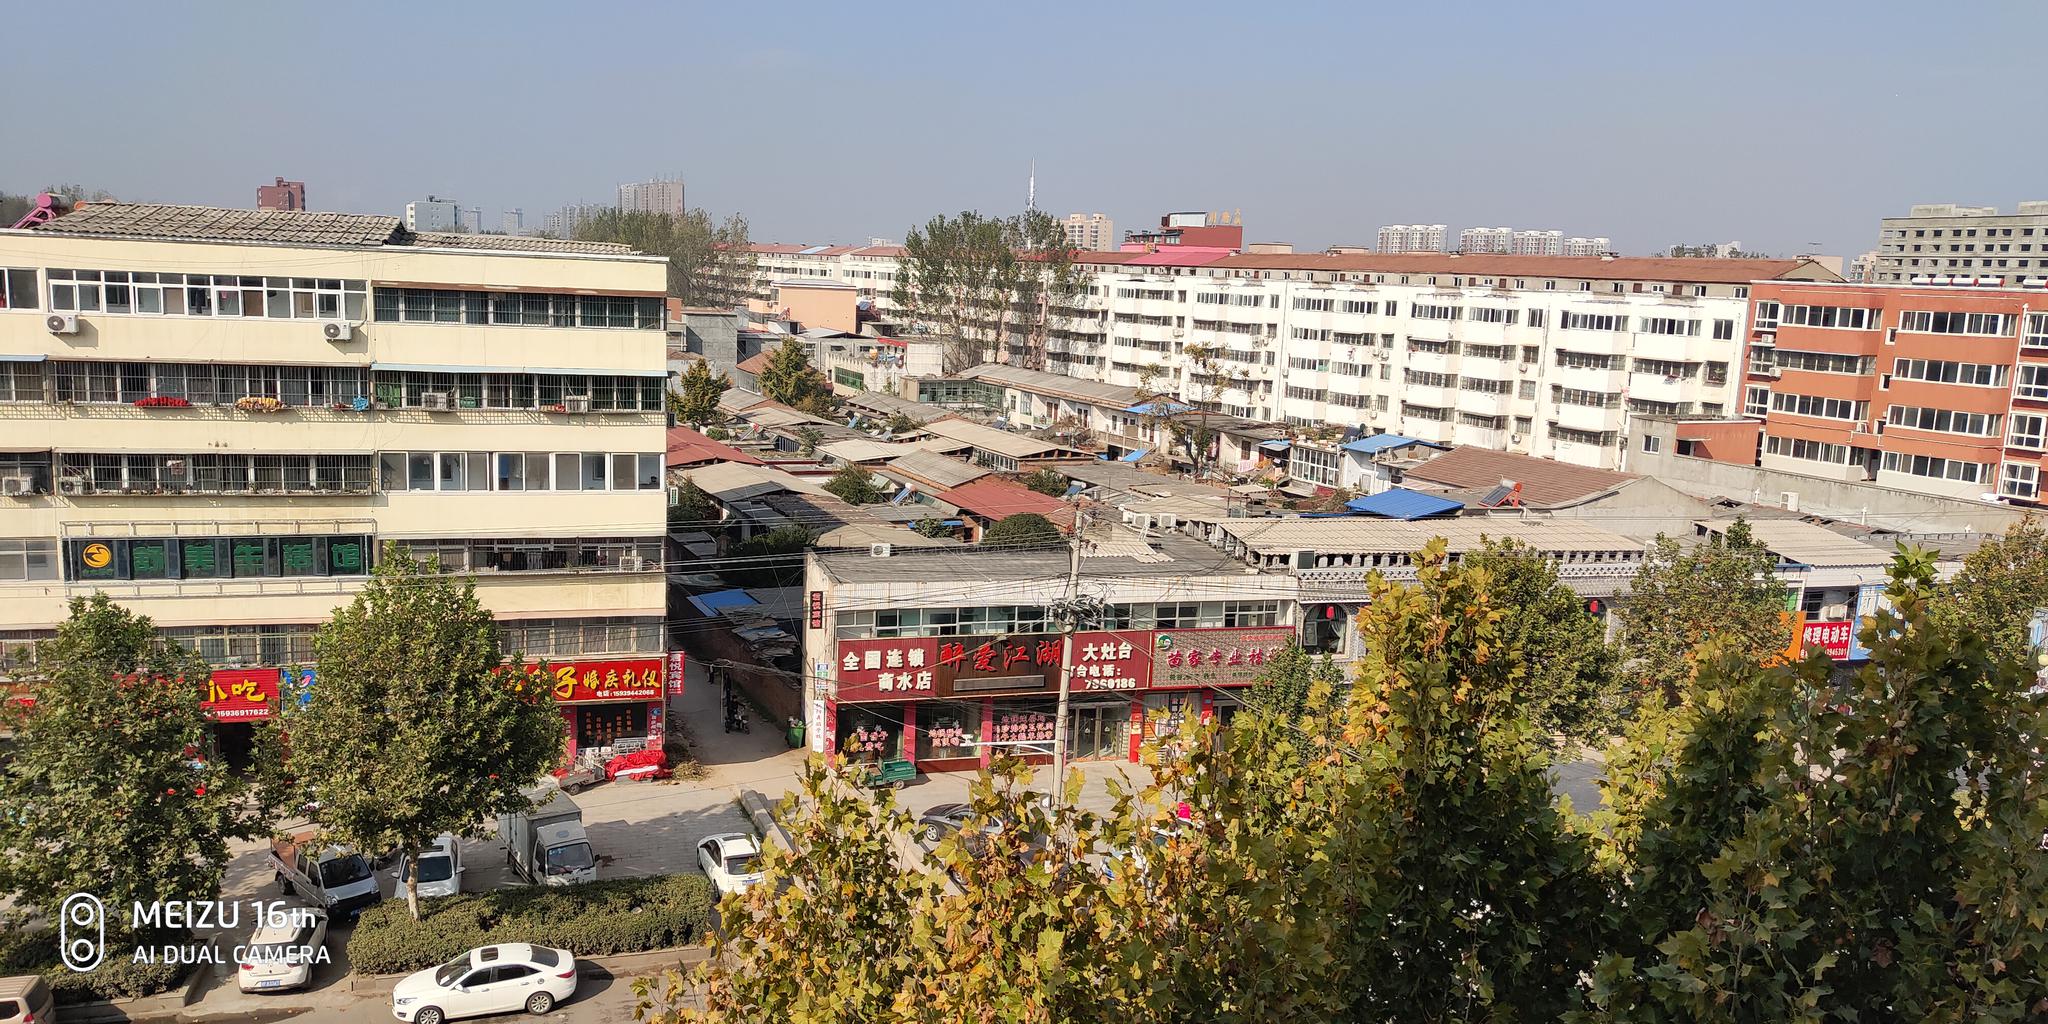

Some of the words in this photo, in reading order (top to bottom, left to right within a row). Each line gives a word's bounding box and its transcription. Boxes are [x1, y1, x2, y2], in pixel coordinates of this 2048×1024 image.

[1803, 625, 1849, 645] 修理电动车
[842, 648, 925, 671] 全国连锁
[1082, 637, 1133, 661] 大灶台
[877, 670, 932, 692] 商水店
